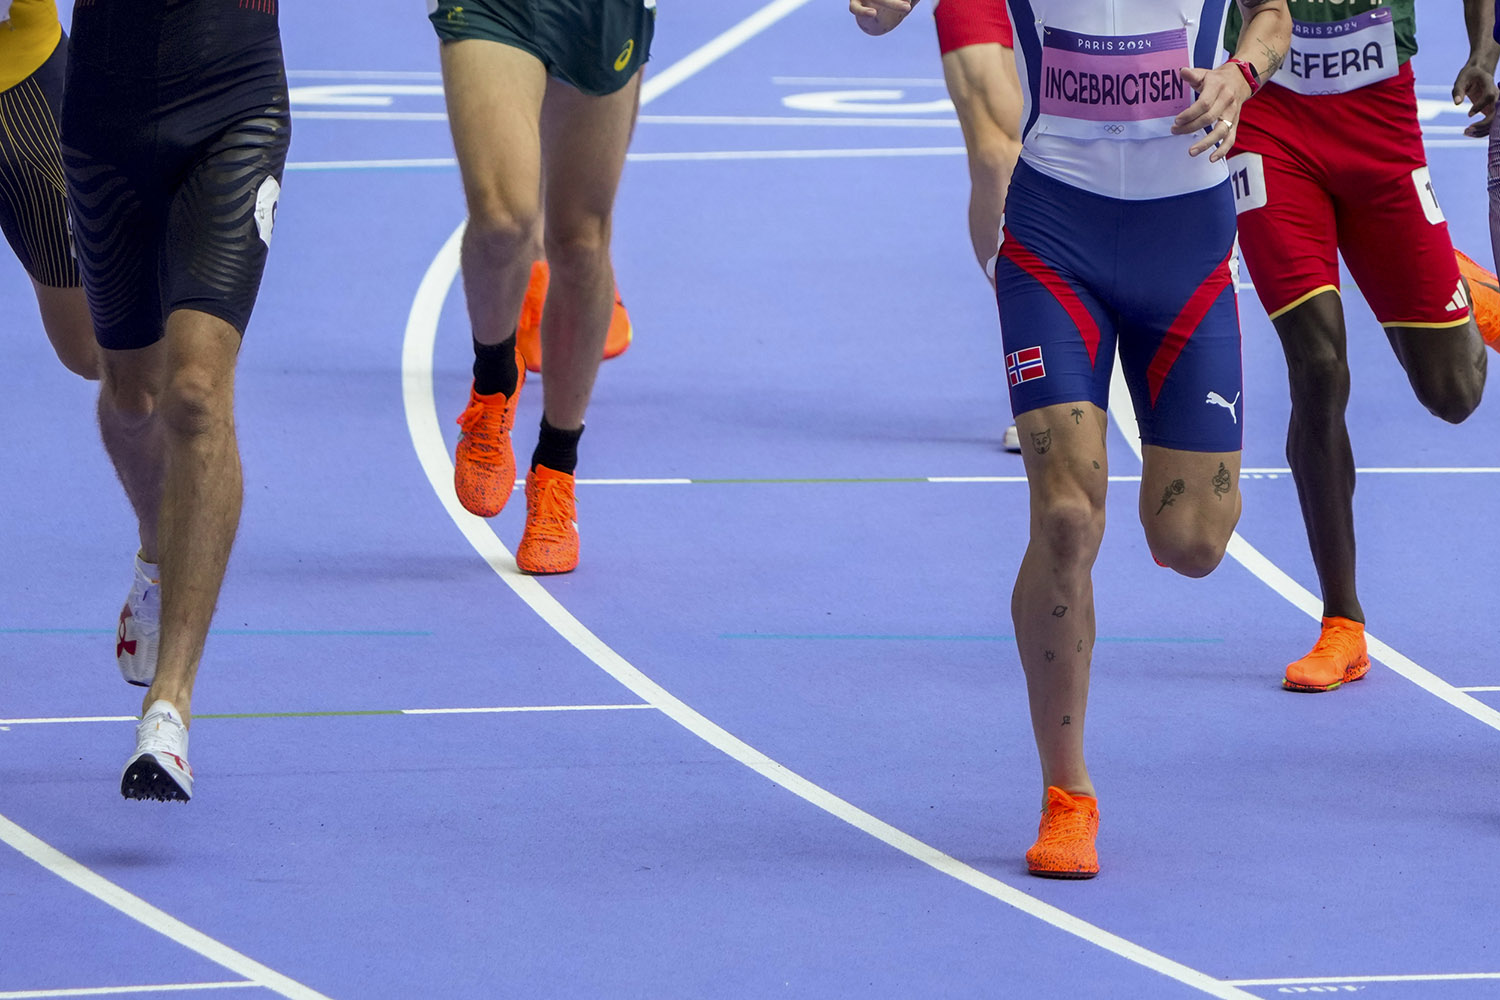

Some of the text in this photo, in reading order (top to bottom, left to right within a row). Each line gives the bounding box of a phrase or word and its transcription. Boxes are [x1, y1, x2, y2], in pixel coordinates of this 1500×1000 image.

[1077, 38, 1152, 50] PARIS 2024
[1292, 21, 1358, 35] ARIS 2024
[1279, 41, 1384, 79] EFERA
[1045, 66, 1184, 105] INGEBRIGTSEN
[1232, 166, 1250, 200] 11
